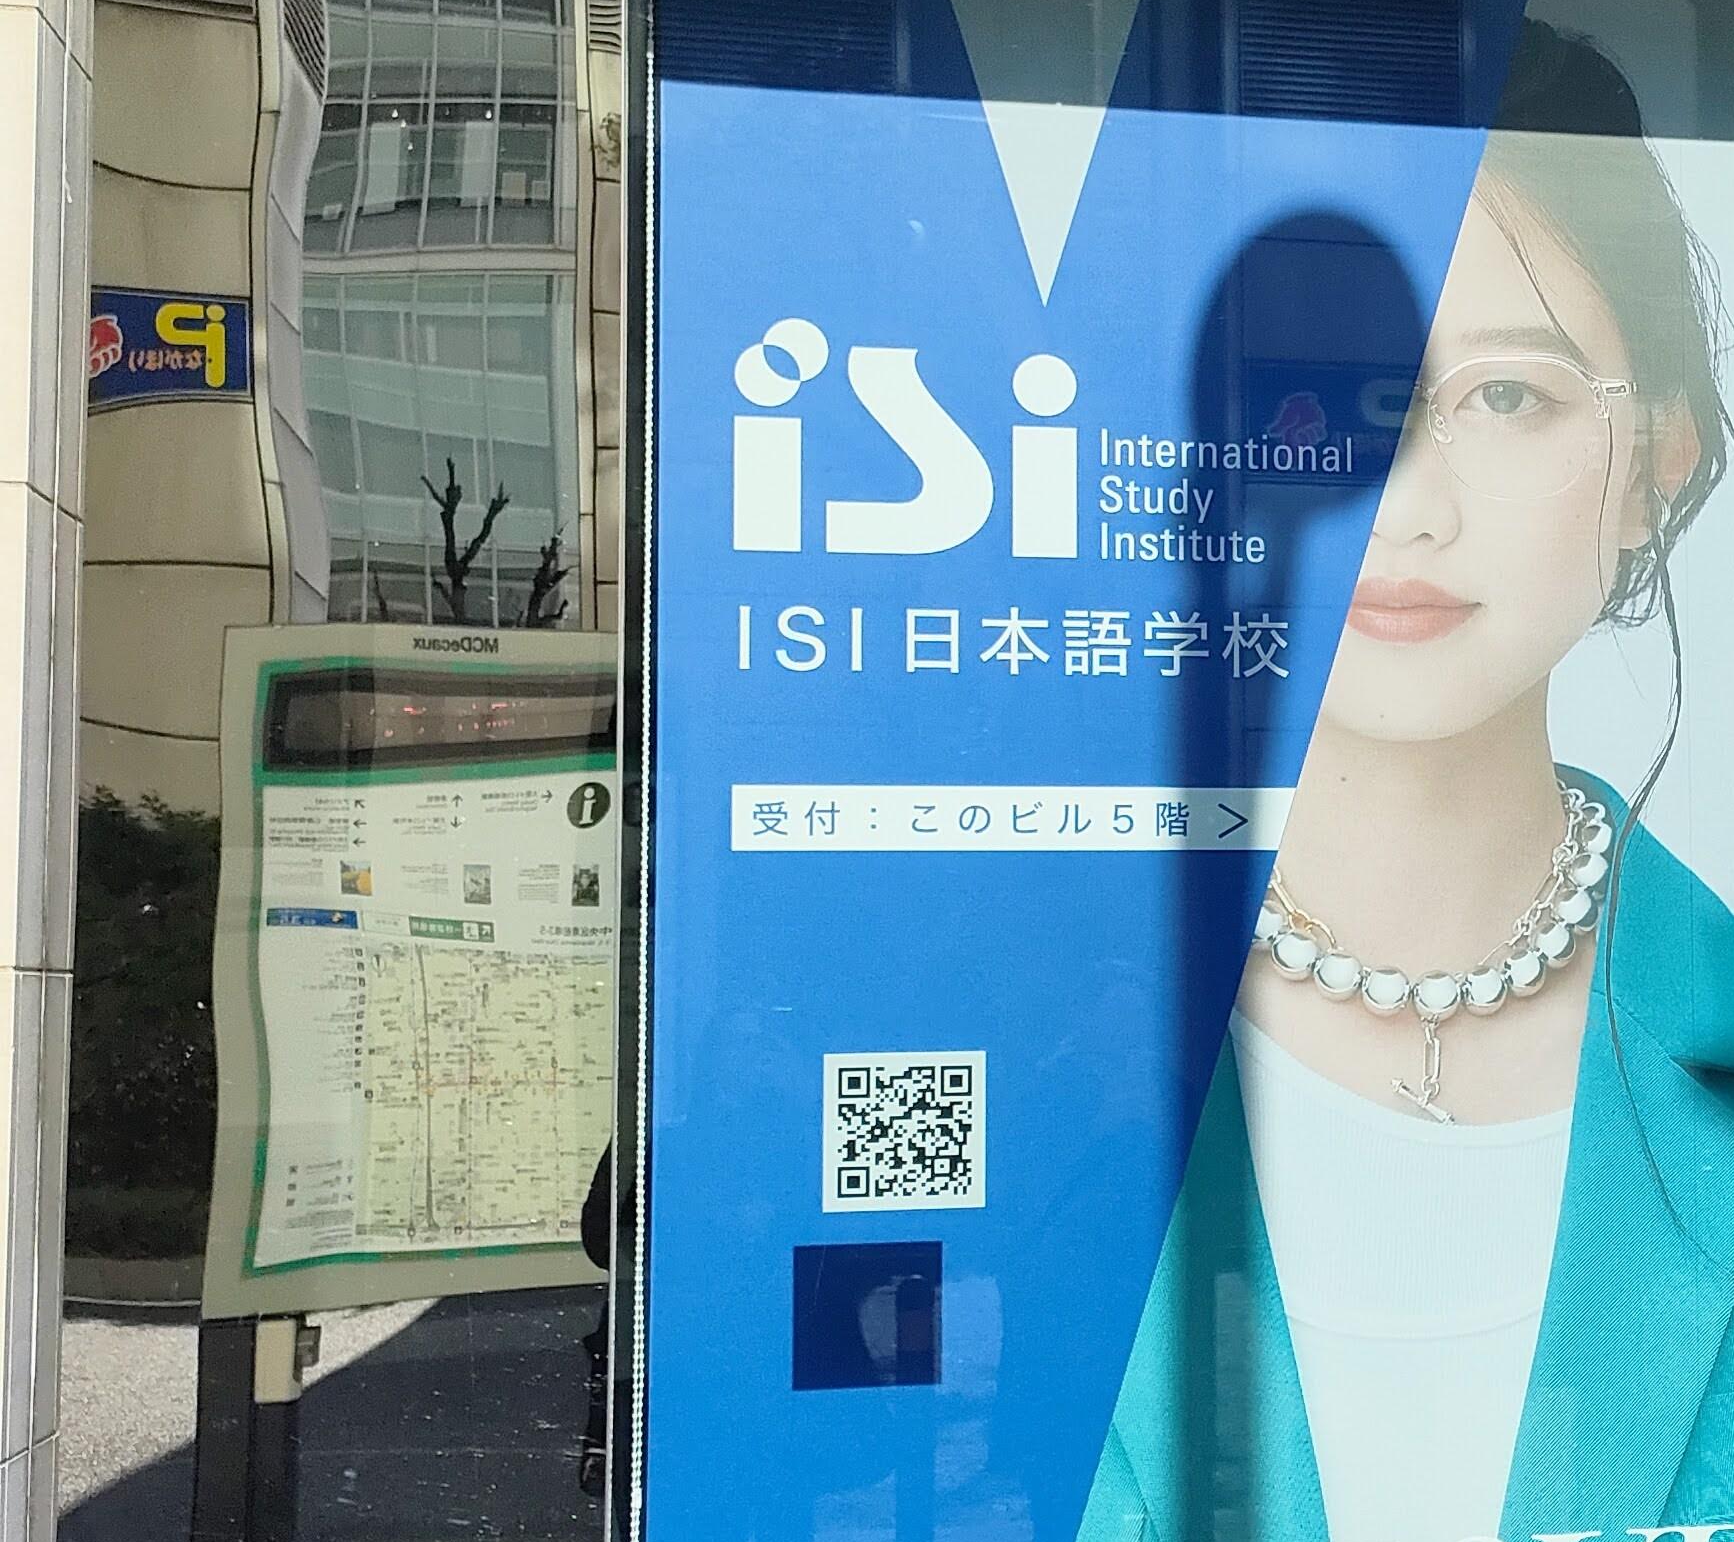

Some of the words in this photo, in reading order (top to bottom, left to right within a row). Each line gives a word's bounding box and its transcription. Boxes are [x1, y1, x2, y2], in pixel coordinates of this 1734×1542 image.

[1100, 427, 1354, 473] International
[1100, 476, 1214, 523] Study
[1100, 521, 1267, 564] Institute
[738, 605, 865, 672] ISI
[906, 607, 1291, 679] 日本語学校
